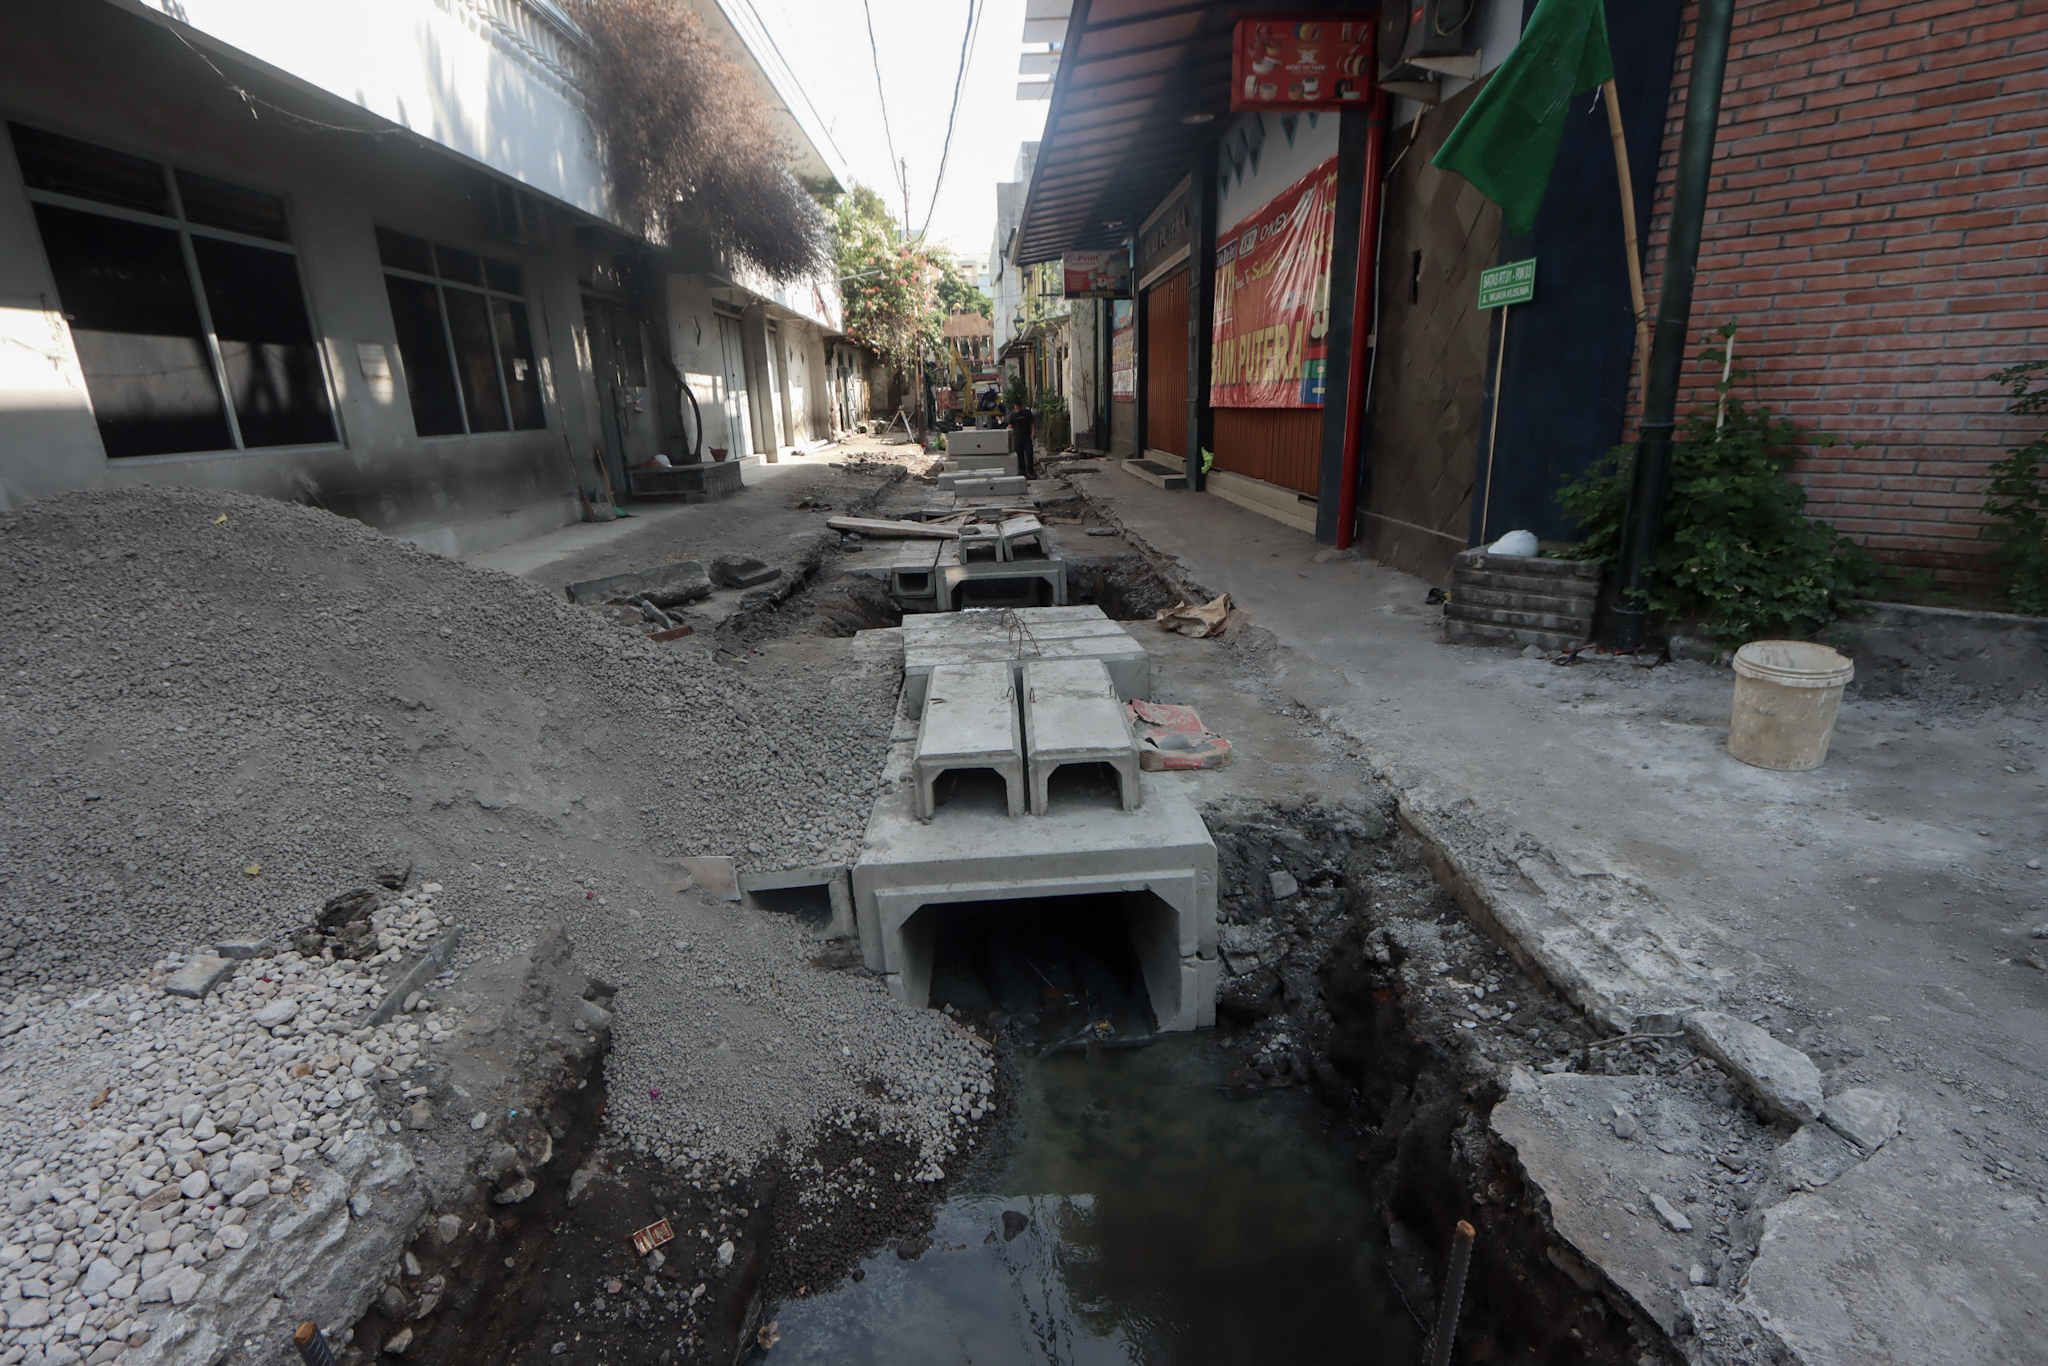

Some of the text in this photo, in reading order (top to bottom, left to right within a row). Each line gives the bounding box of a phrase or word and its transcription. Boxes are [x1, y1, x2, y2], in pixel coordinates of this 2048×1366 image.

[1483, 272, 1498, 288] BATAS
[1489, 290, 1507, 302] WIJAYA
[1507, 285, 1530, 298] KUSUMA
[1238, 319, 1303, 384] PUTERA
